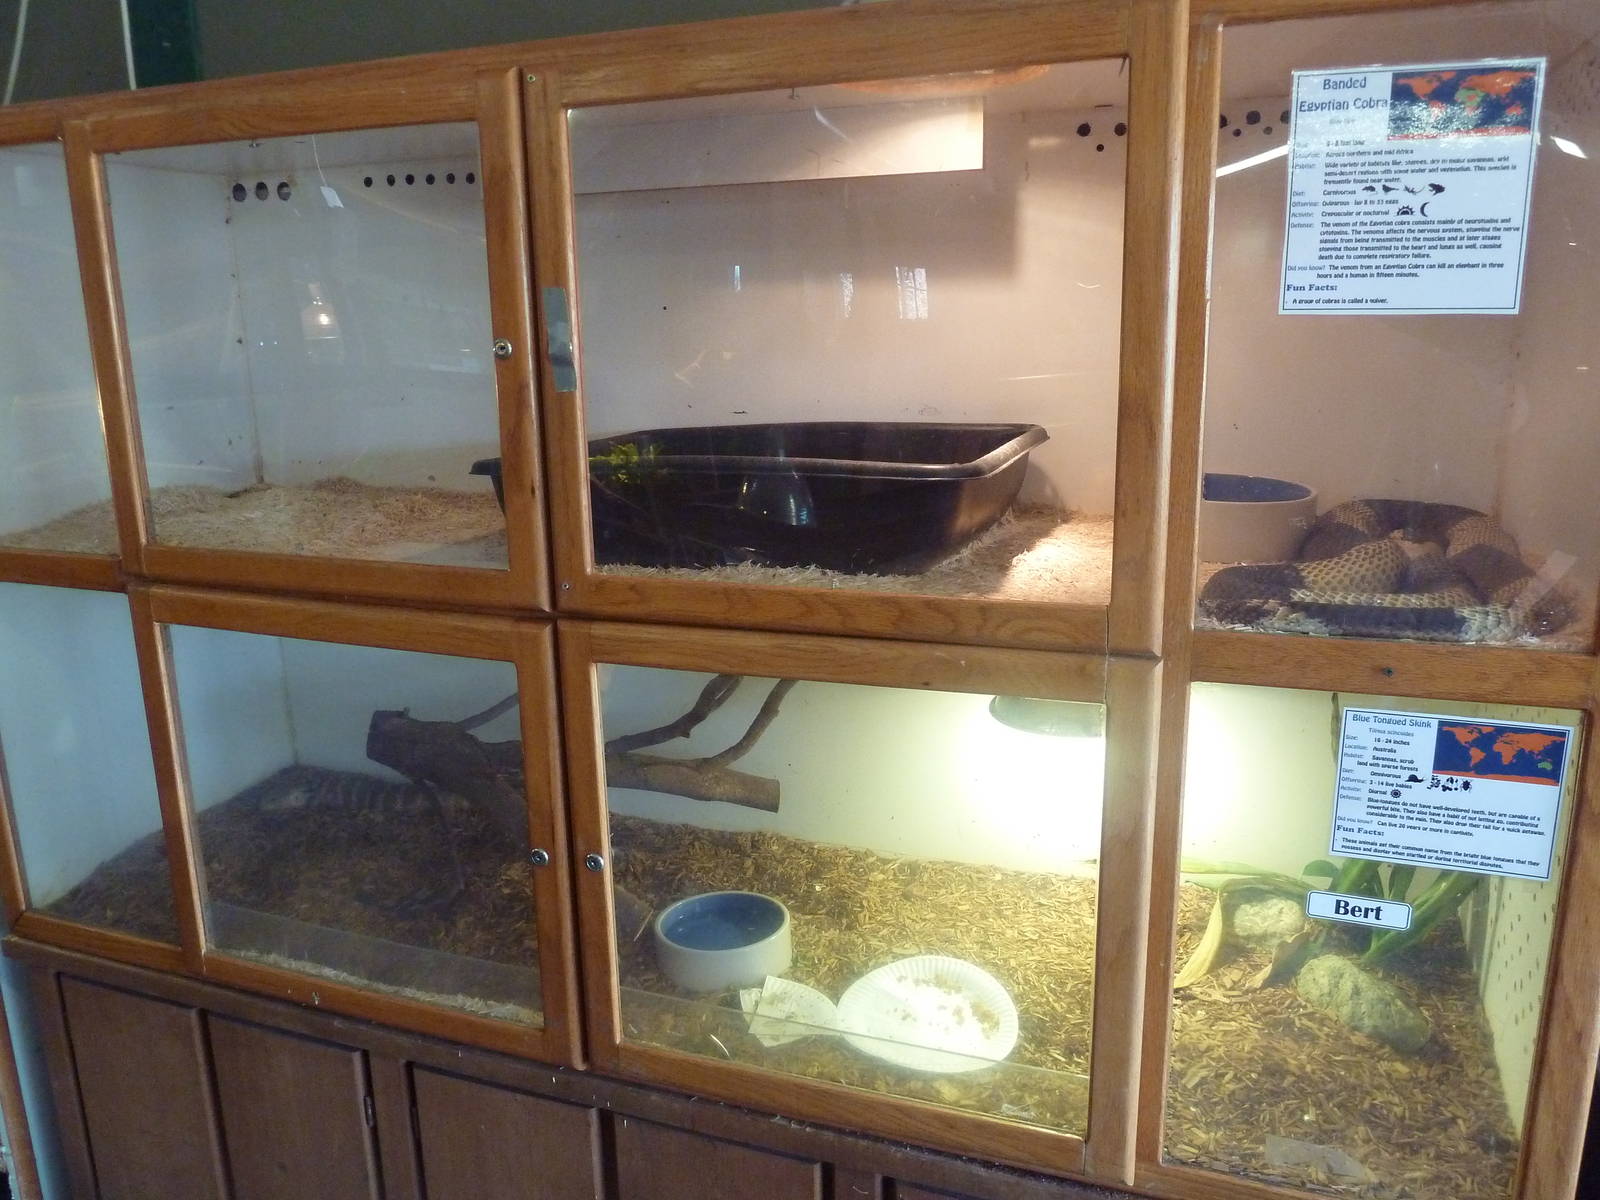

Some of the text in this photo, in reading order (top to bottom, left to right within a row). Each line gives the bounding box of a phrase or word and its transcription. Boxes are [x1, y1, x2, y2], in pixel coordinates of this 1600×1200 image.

[1323, 77, 1367, 90] Banded
[1299, 97, 1388, 112] Egyptian Cobra
[1352, 714, 1432, 728] Blue Tongued Skink
[1337, 825, 1384, 836] Fun Facts:
[1334, 899, 1383, 920] Bert
